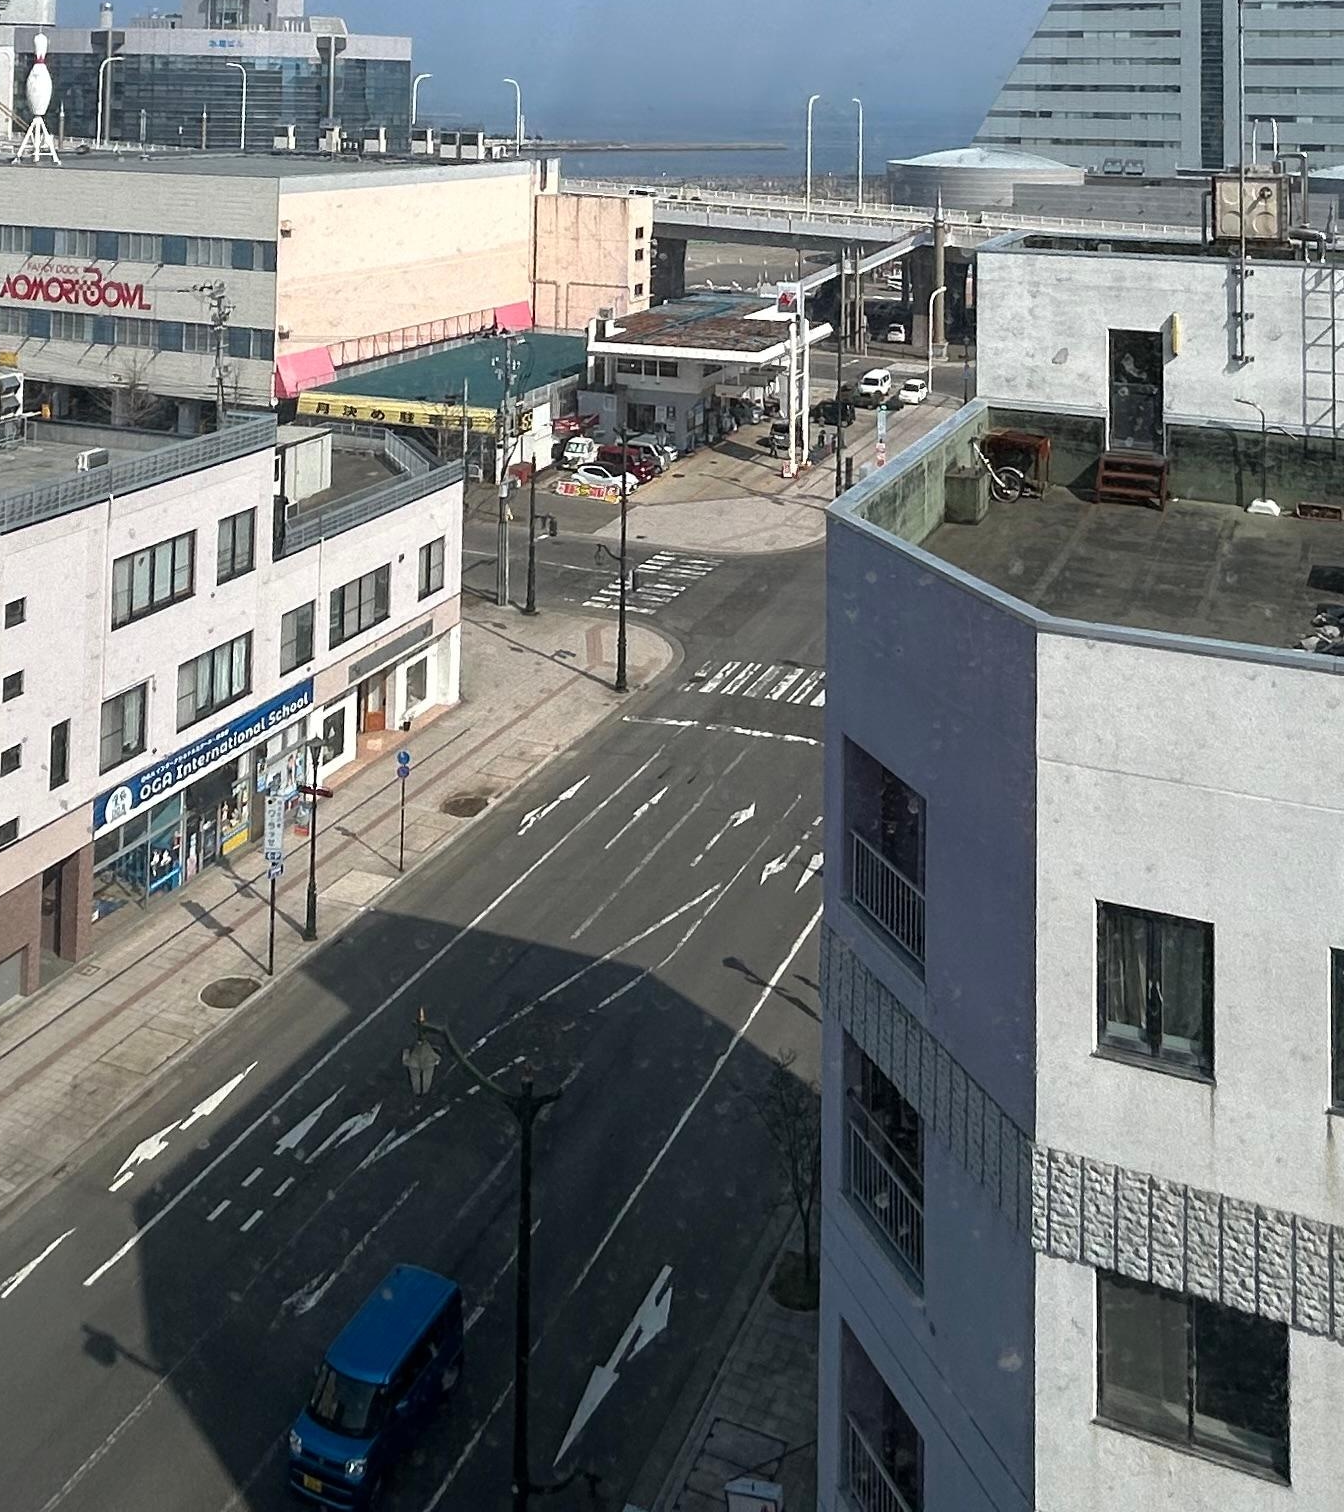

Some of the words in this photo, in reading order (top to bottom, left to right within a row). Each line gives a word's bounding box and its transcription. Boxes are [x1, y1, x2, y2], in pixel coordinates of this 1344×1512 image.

[0, 274, 79, 305] AOMORI
[83, 266, 151, 310] BOWL
[56, 263, 80, 275] DOCK
[139, 772, 173, 801] OGA
[175, 717, 266, 779] International
[268, 691, 309, 726] School
